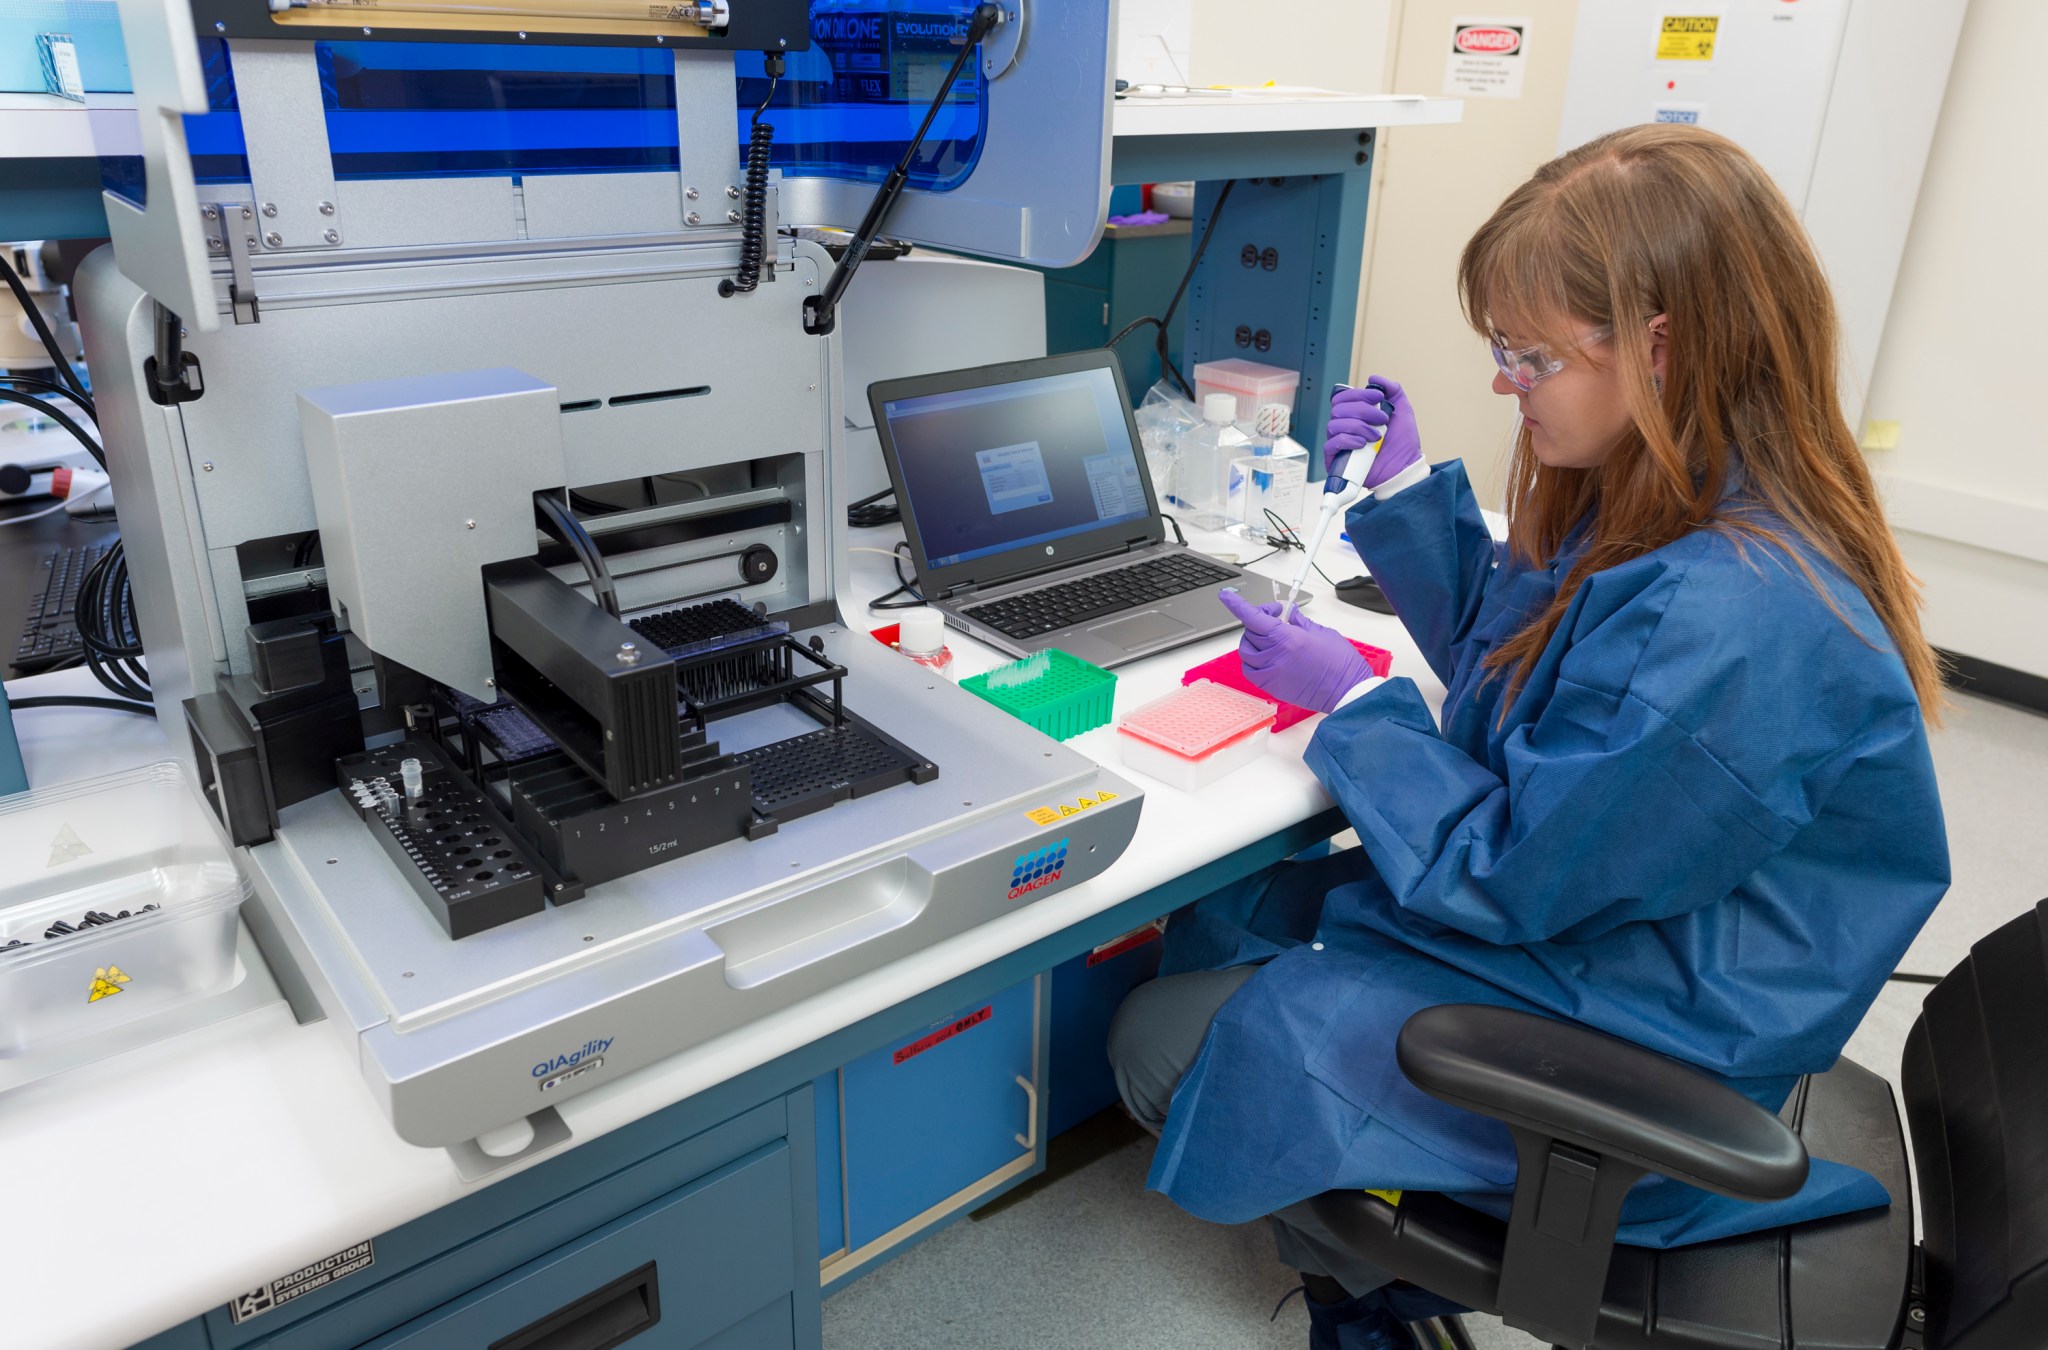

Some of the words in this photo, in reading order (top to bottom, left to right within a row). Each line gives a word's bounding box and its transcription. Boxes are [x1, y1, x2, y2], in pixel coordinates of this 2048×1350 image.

[896, 22, 958, 37] EVOLUTION
[1664, 17, 1718, 32] CAUTION
[1461, 32, 1515, 49] DANGER
[1656, 110, 1697, 123] NOTICE
[600, 823, 606, 832] 2
[623, 815, 629, 824] 3
[646, 808, 652, 816] 4
[669, 801, 675, 810] 5
[691, 794, 697, 803] 6
[714, 787, 720, 796] 7
[734, 781, 740, 790] 8
[1007, 869, 1062, 900] QIAGEN
[531, 1036, 615, 1078] QIAgility
[273, 1241, 369, 1291] PRODUCTION
[275, 1273, 330, 1304] SYSTEMS
[332, 1255, 371, 1279] GROUP
